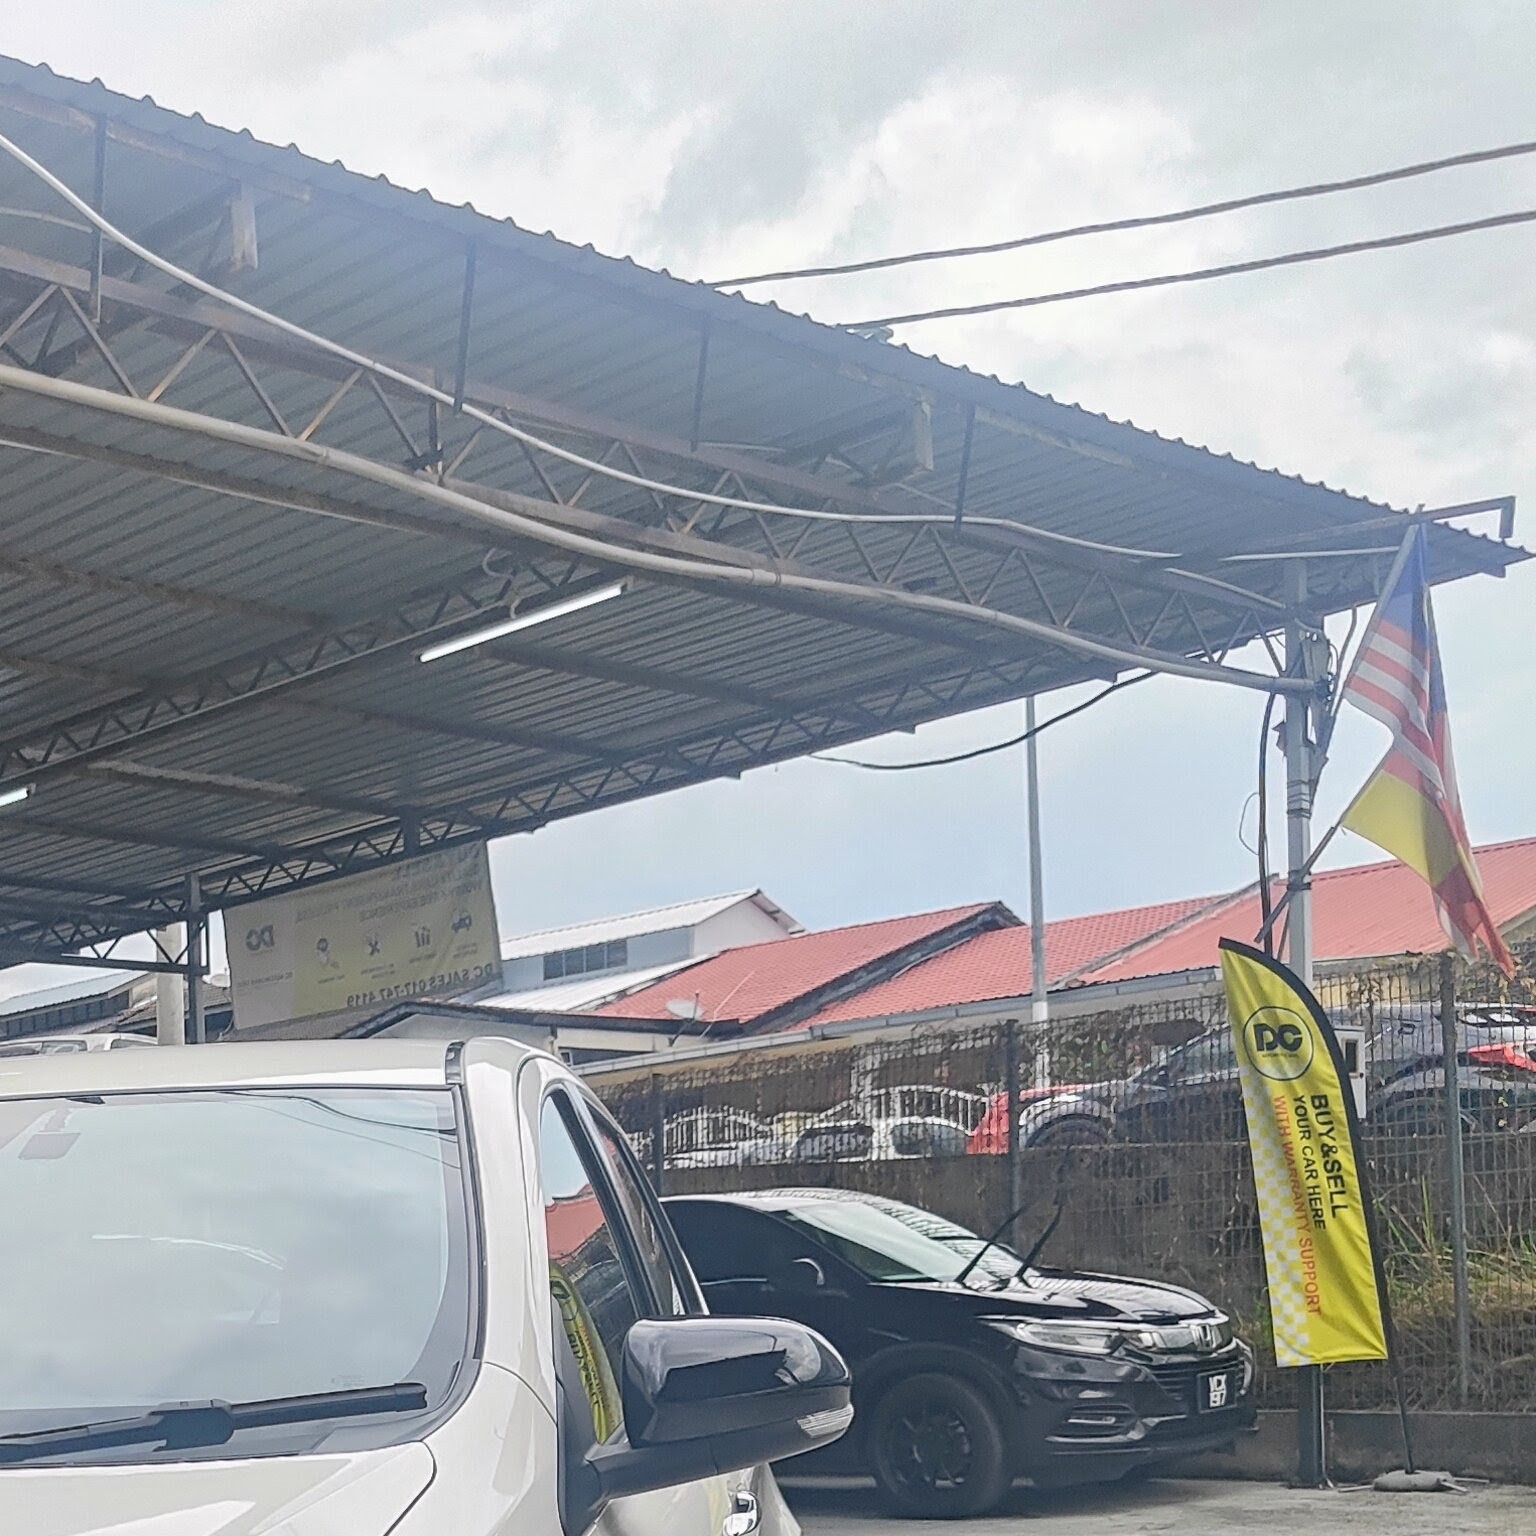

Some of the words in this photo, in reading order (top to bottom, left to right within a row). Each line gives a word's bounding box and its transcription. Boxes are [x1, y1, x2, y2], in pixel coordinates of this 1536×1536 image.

[1253, 1023, 1303, 1051] DC
[1274, 1095, 1291, 1137] WITH
[1293, 1095, 1311, 1141] YOUR
[1302, 1146, 1319, 1181] CAR
[1311, 1094, 1348, 1218] BUY&SELL
[1282, 1141, 1310, 1233] WARRANTY
[1307, 1185, 1326, 1230] HERE
[1299, 1237, 1322, 1316] SUPPORT
